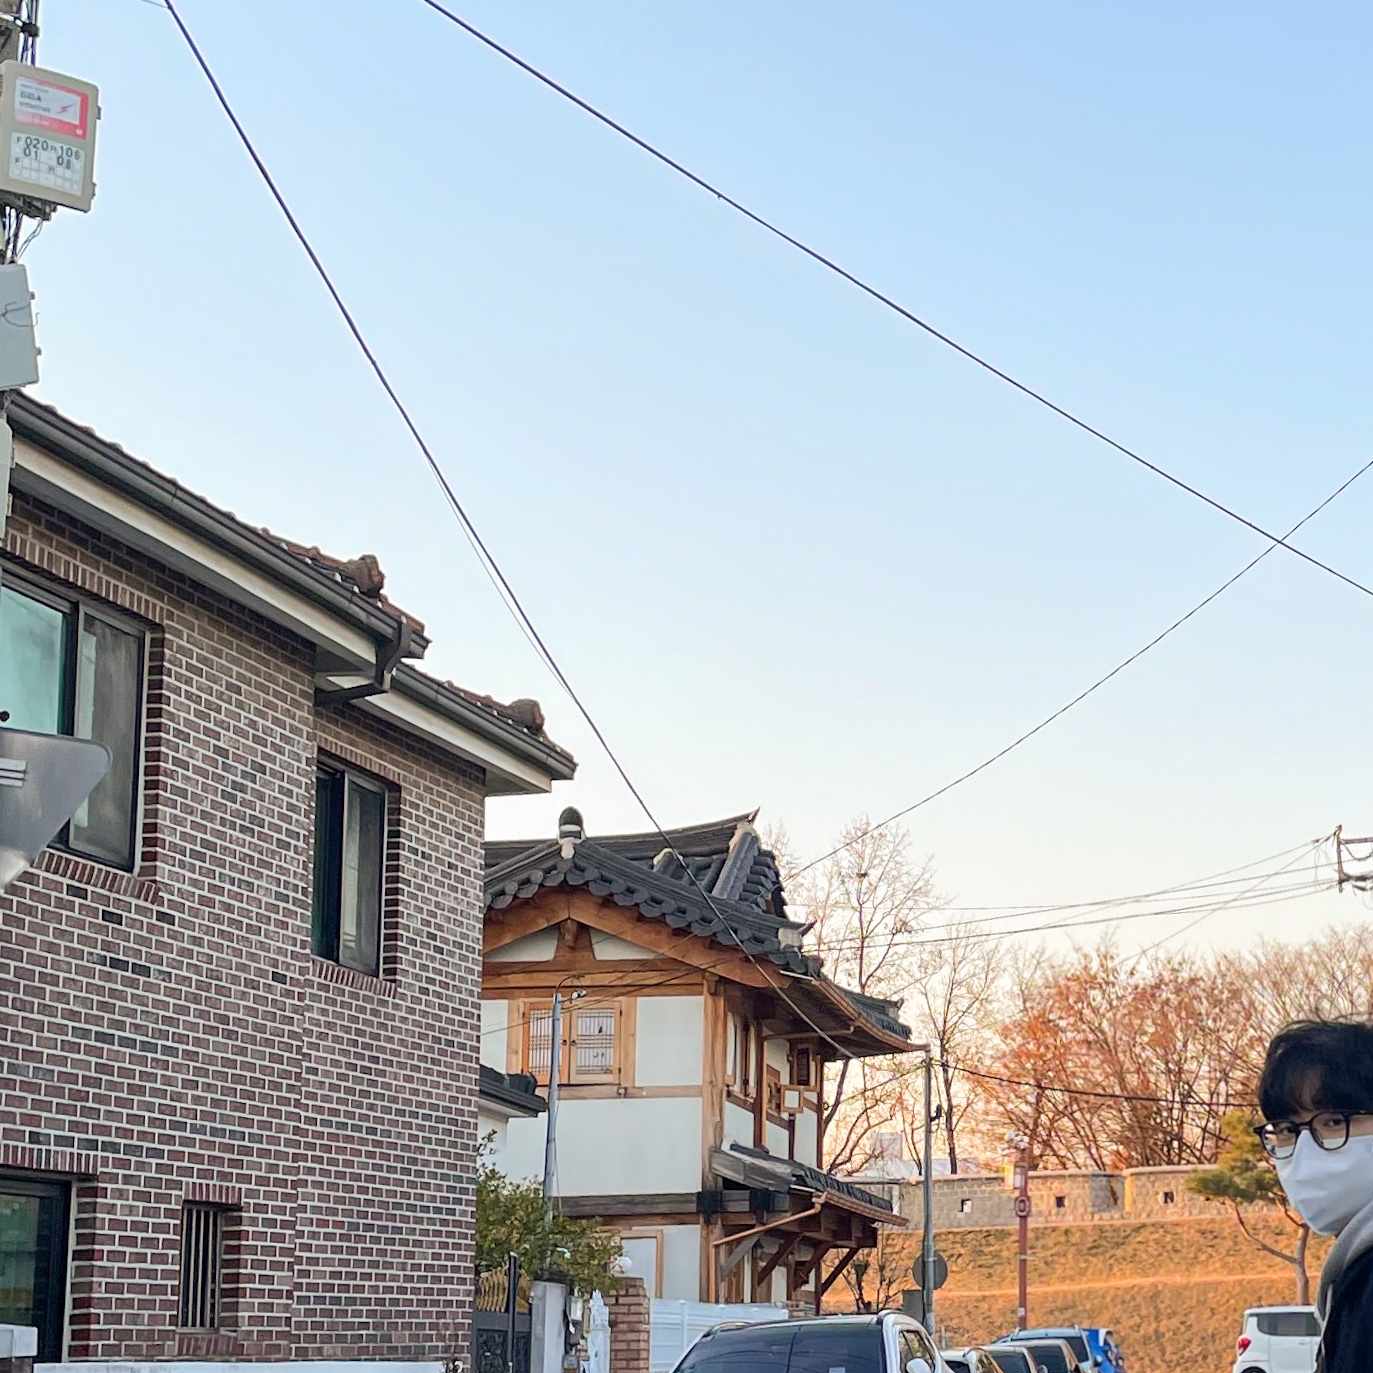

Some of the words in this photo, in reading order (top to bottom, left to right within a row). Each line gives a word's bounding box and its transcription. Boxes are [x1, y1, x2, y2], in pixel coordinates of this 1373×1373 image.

[24, 147, 38, 160] 01
[57, 156, 71, 169] 08
[25, 136, 48, 151] 020
[59, 145, 80, 160] 106
